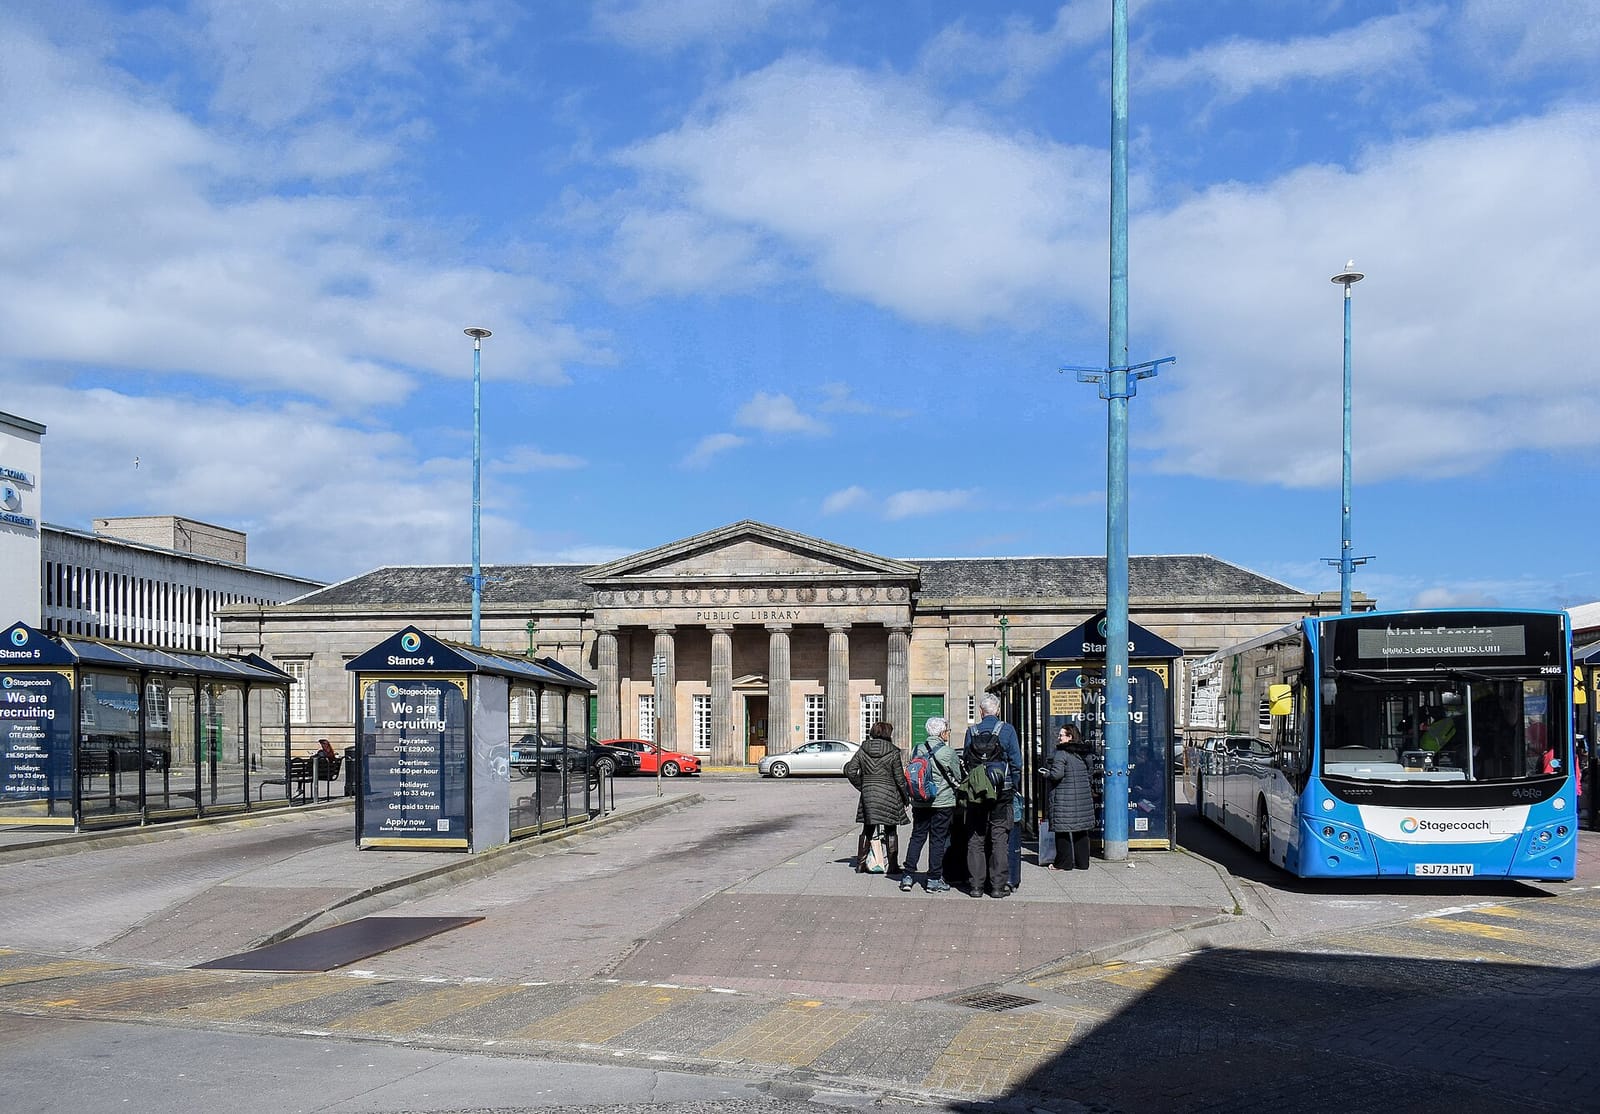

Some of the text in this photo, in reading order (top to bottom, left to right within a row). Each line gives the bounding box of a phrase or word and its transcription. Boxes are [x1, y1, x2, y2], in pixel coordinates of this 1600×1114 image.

[696, 611, 800, 620] PUBLIC LIBRARY
[1128, 642, 1135, 652] 3
[0, 650, 40, 658] Stance 5
[388, 656, 434, 665] Stance 4
[14, 679, 52, 687] Stagecoach
[399, 688, 442, 696] Stagecoach
[7, 692, 48, 702] We are
[392, 702, 436, 714] We are
[0, 706, 54, 720] recruiting
[382, 718, 446, 732] recruiting
[1420, 820, 1488, 832] Stagecoach
[1422, 865, 1472, 874] SJ73 HTV
